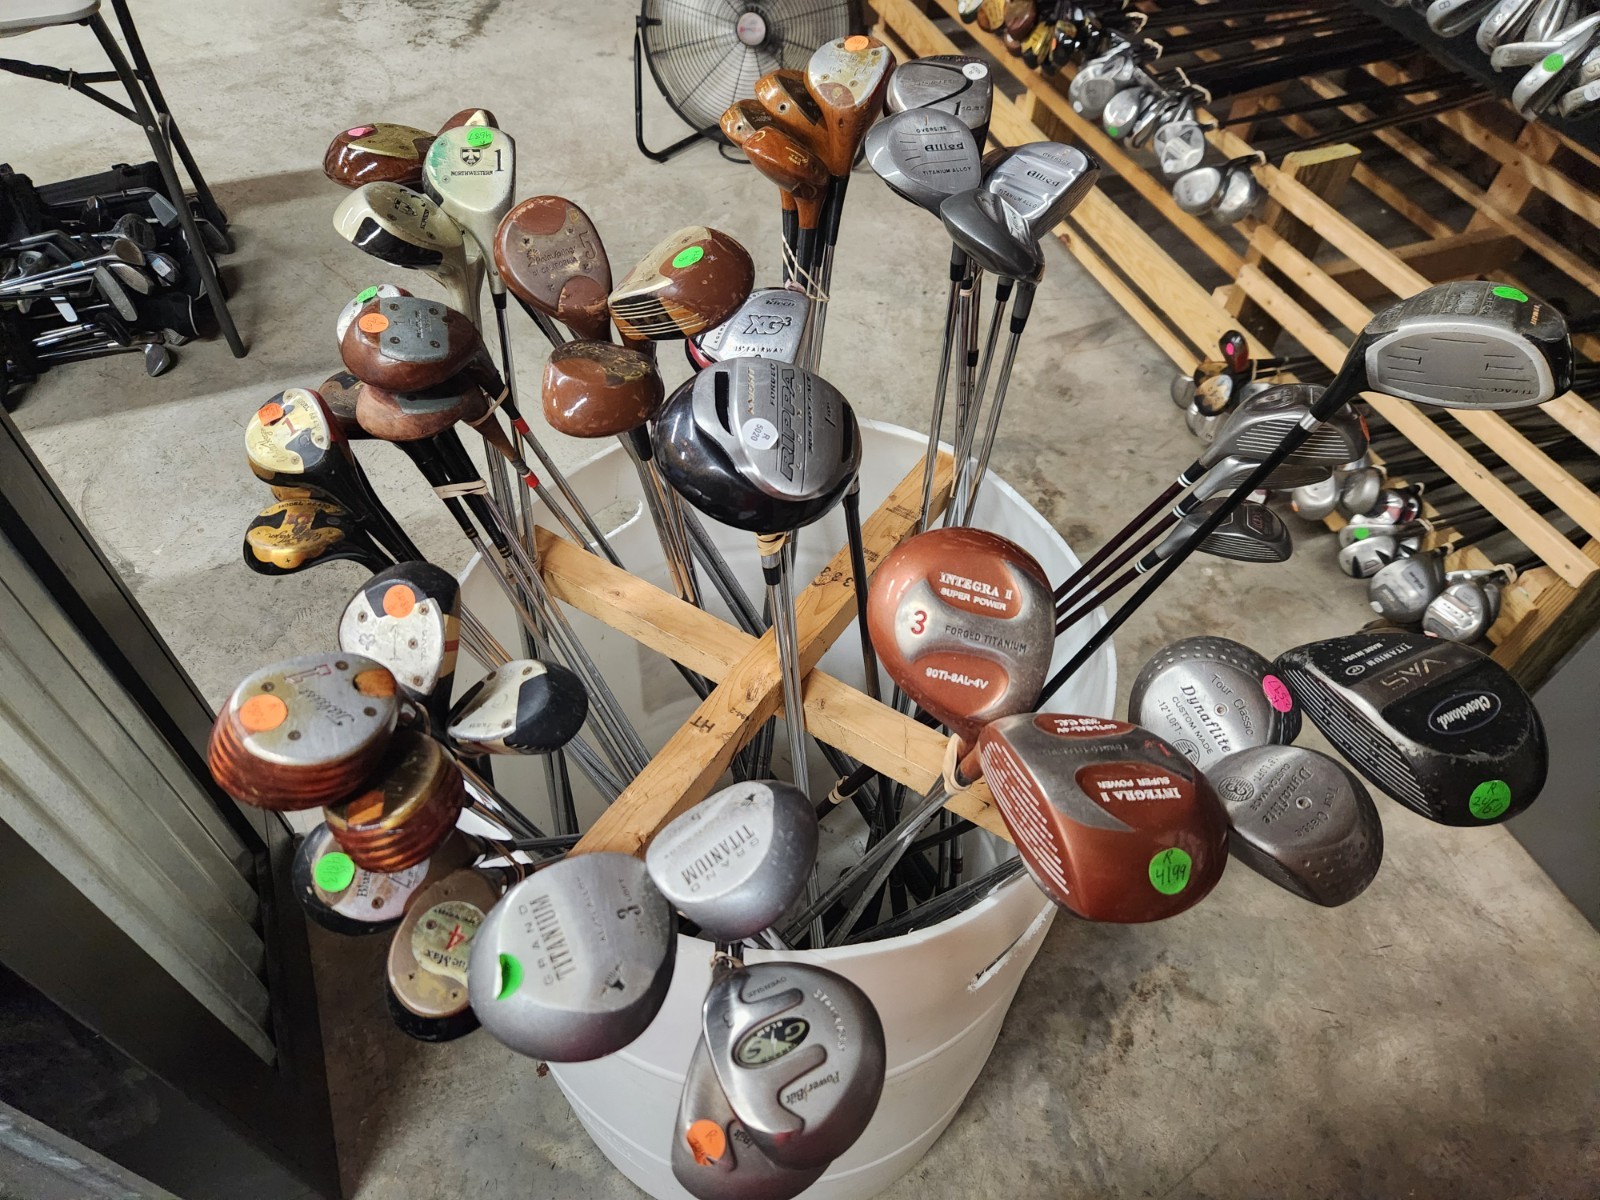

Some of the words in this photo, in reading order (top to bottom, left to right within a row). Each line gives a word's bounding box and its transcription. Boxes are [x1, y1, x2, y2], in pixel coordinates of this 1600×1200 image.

[494, 148, 504, 172] 1
[924, 142, 965, 152] Allied
[1027, 170, 1060, 187] Allied
[578, 230, 597, 260] 5
[750, 423, 763, 442] 5020
[780, 368, 795, 482] RIPPA
[939, 571, 999, 598] INTEGRA
[939, 587, 970, 602] SUPER
[973, 595, 1007, 611] POWER
[911, 610, 928, 635] 3
[945, 625, 981, 642] FORGED
[984, 634, 1027, 653] TITANIUM
[1366, 642, 1413, 667] TITANIUM
[1380, 658, 1447, 690] VAS
[1209, 673, 1234, 696] Tour
[1233, 697, 1254, 736] Classic
[1436, 695, 1491, 730] Cleveland
[690, 715, 716, 733] HT
[1172, 696, 1197, 730] CUSTOM
[1194, 730, 1214, 755] MADE
[1180, 685, 1231, 753] Dynaflite
[1097, 779, 1134, 789] POWER
[1136, 776, 1170, 787] SUPER
[1265, 763, 1290, 791] CUSTOM
[1487, 782, 1497, 795] R
[1112, 787, 1182, 802] INTEGRA
[1262, 766, 1313, 824] Dynaflite
[1294, 811, 1329, 837] Classic
[681, 824, 755, 885] TITANIUM
[1163, 849, 1173, 864] R
[1156, 864, 1187, 886] 4199
[616, 904, 642, 920] 3
[445, 923, 465, 951] 4
[518, 904, 555, 986] GRAND
[530, 894, 577, 981] TITANIUM
